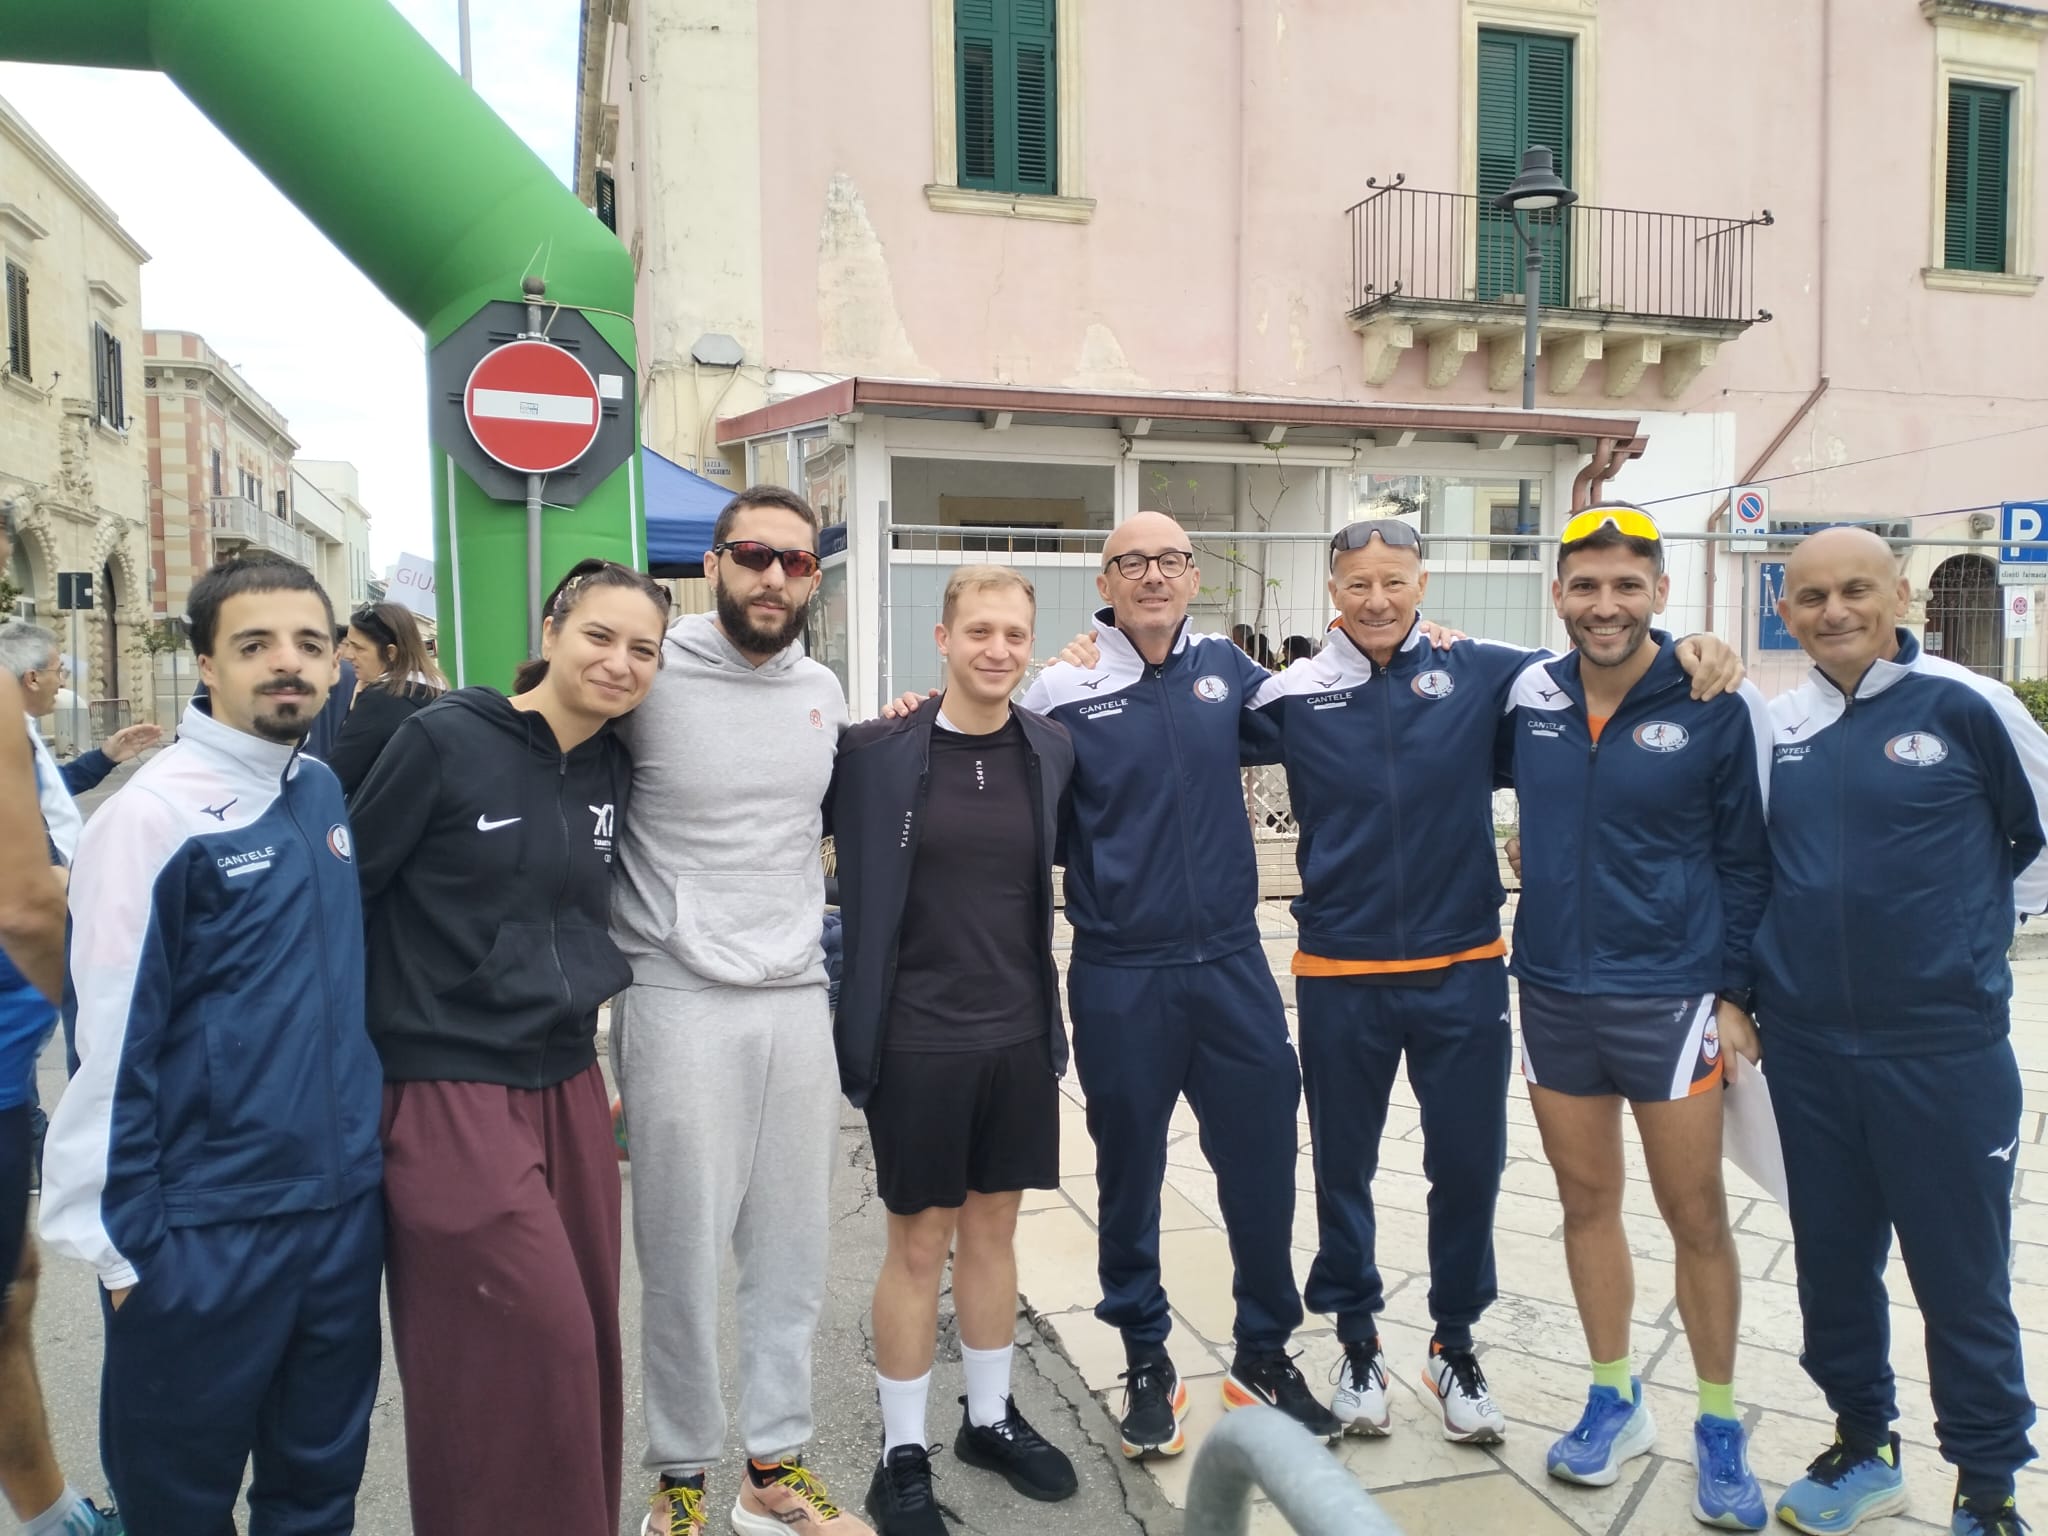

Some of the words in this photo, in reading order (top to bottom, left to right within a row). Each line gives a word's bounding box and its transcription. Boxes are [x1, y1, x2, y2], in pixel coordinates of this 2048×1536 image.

[2010, 508, 2042, 557] P
[2022, 570, 2047, 578] farmacia
[1079, 698, 1129, 714] CANTELE
[1306, 691, 1353, 704] CANTELE
[900, 811, 913, 848] KIPSTA
[217, 846, 276, 868] CANTELE
